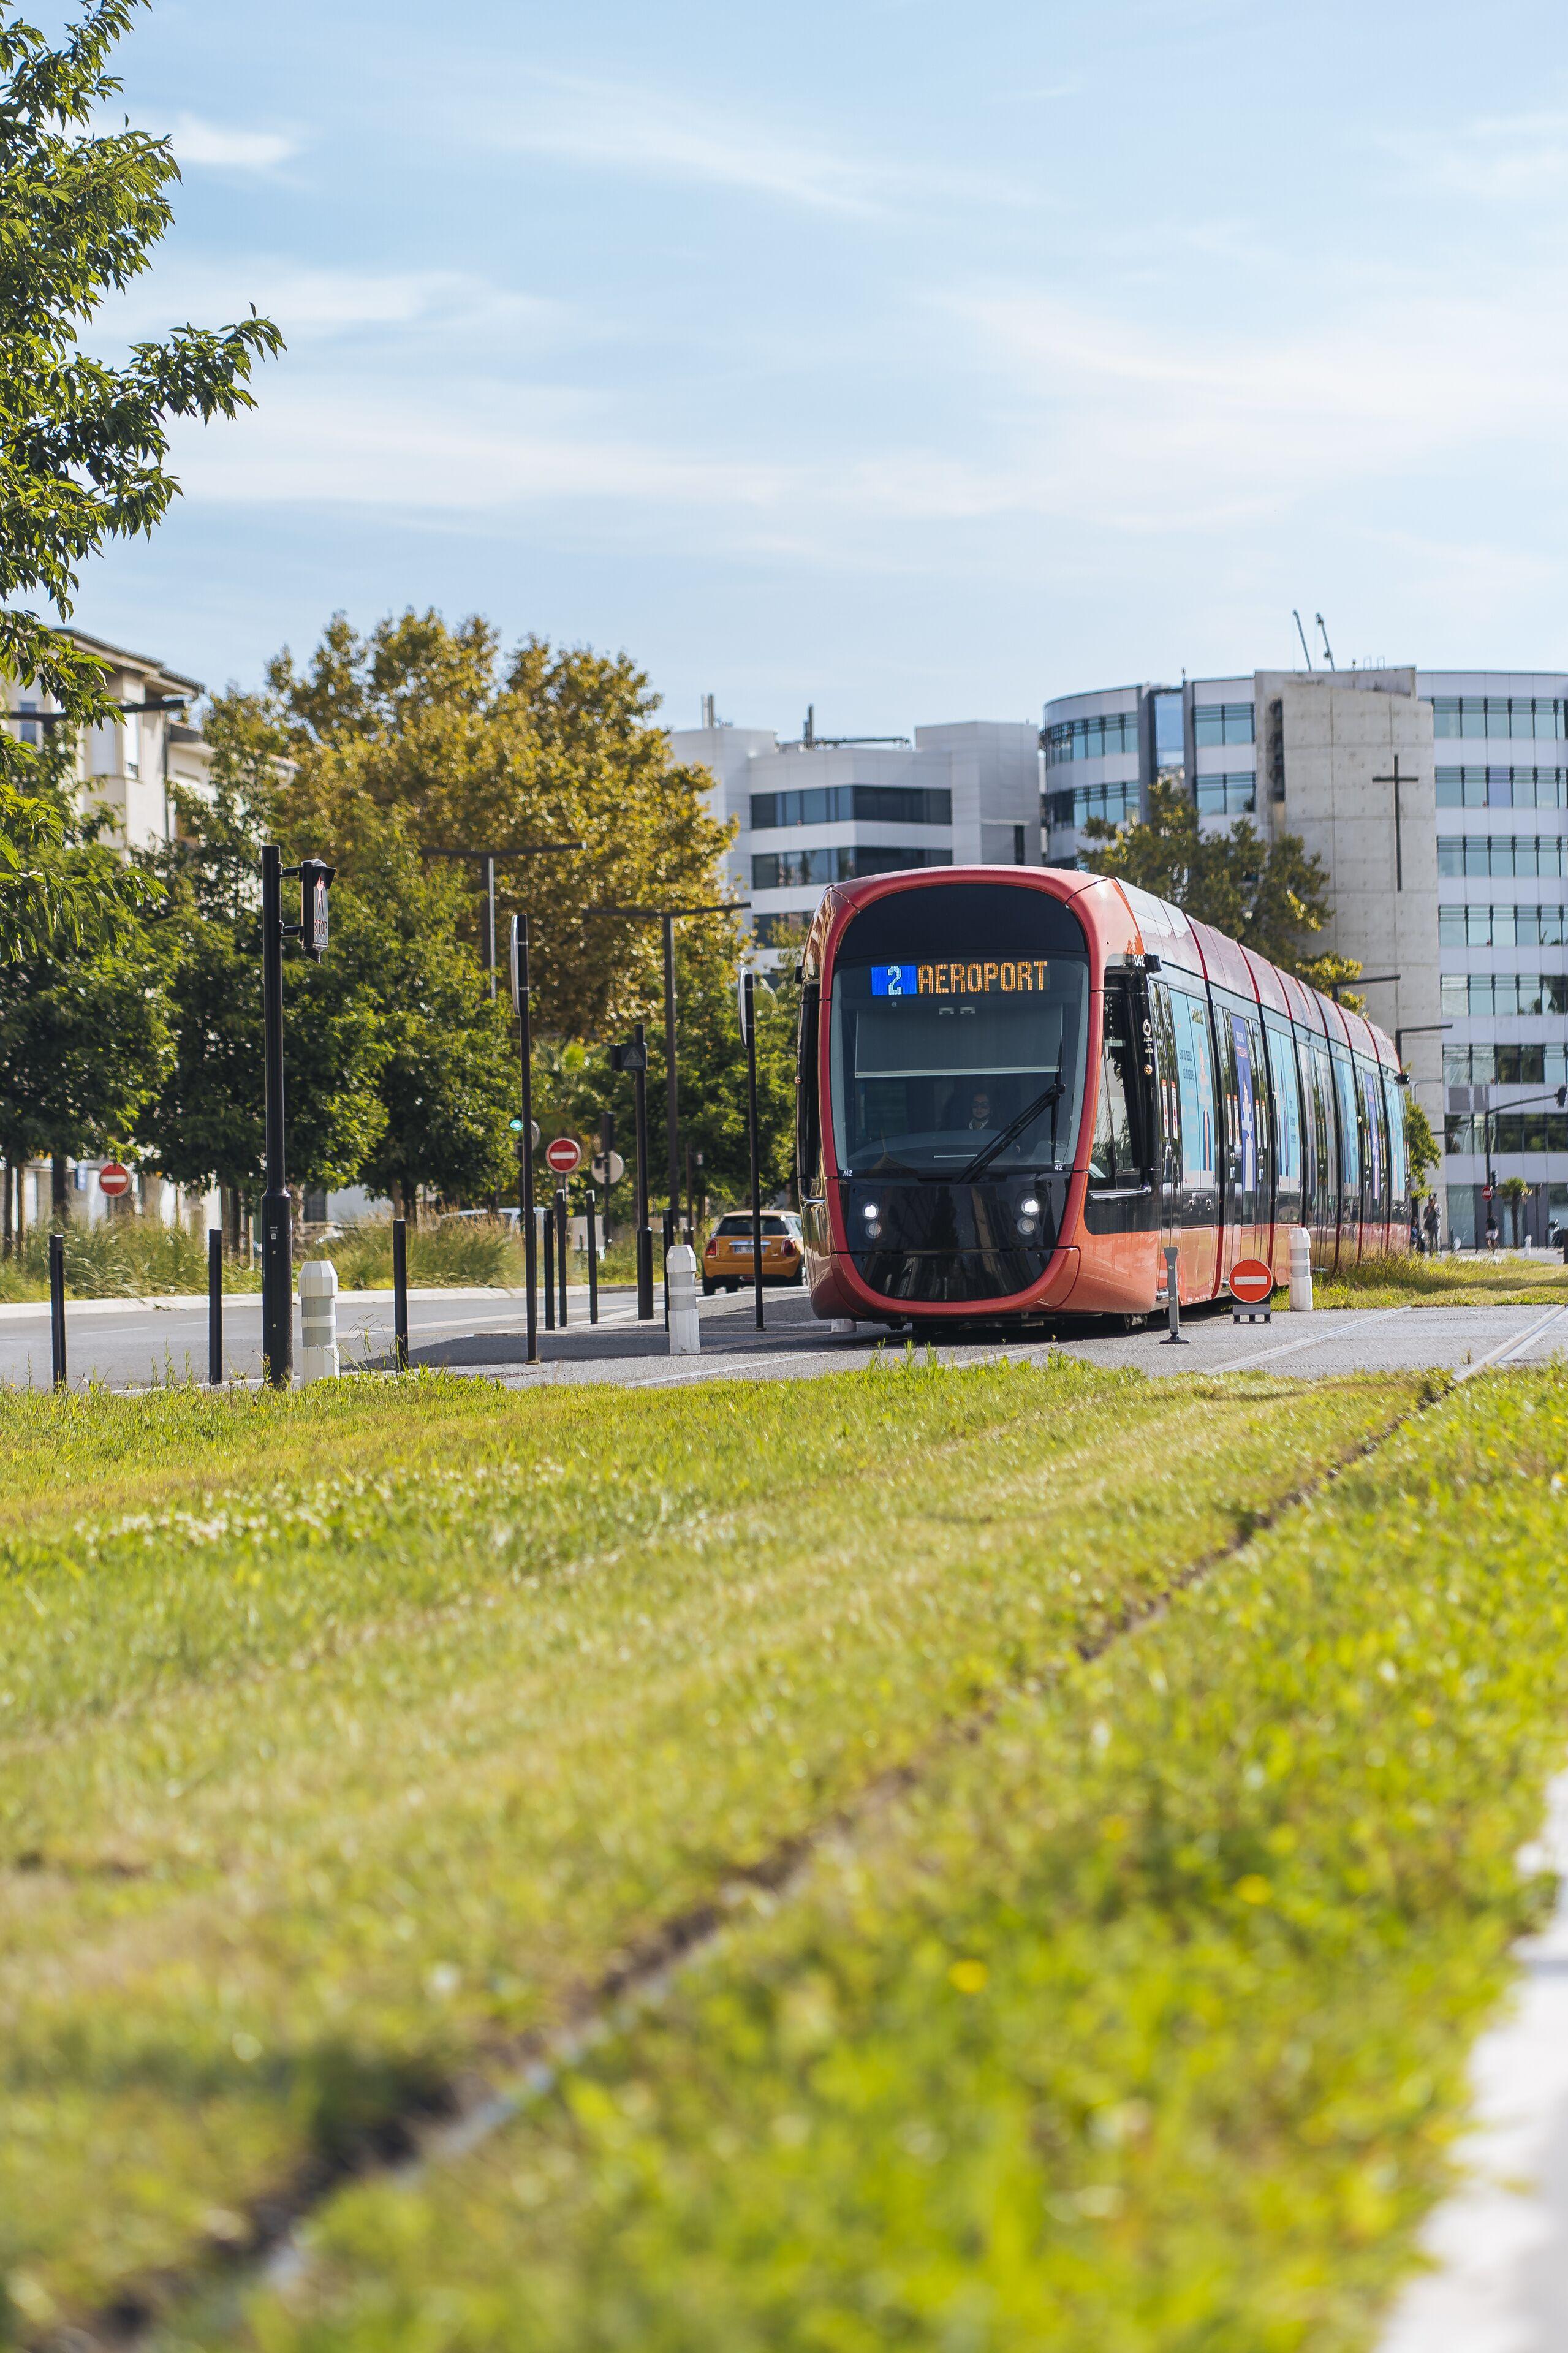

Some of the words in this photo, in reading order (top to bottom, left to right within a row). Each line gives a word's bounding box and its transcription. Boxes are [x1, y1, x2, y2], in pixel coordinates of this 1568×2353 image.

[314, 919, 327, 936] STOP
[1134, 954, 1145, 967] 042
[888, 966, 902, 995] 2
[918, 961, 1047, 994] AEROPORT
